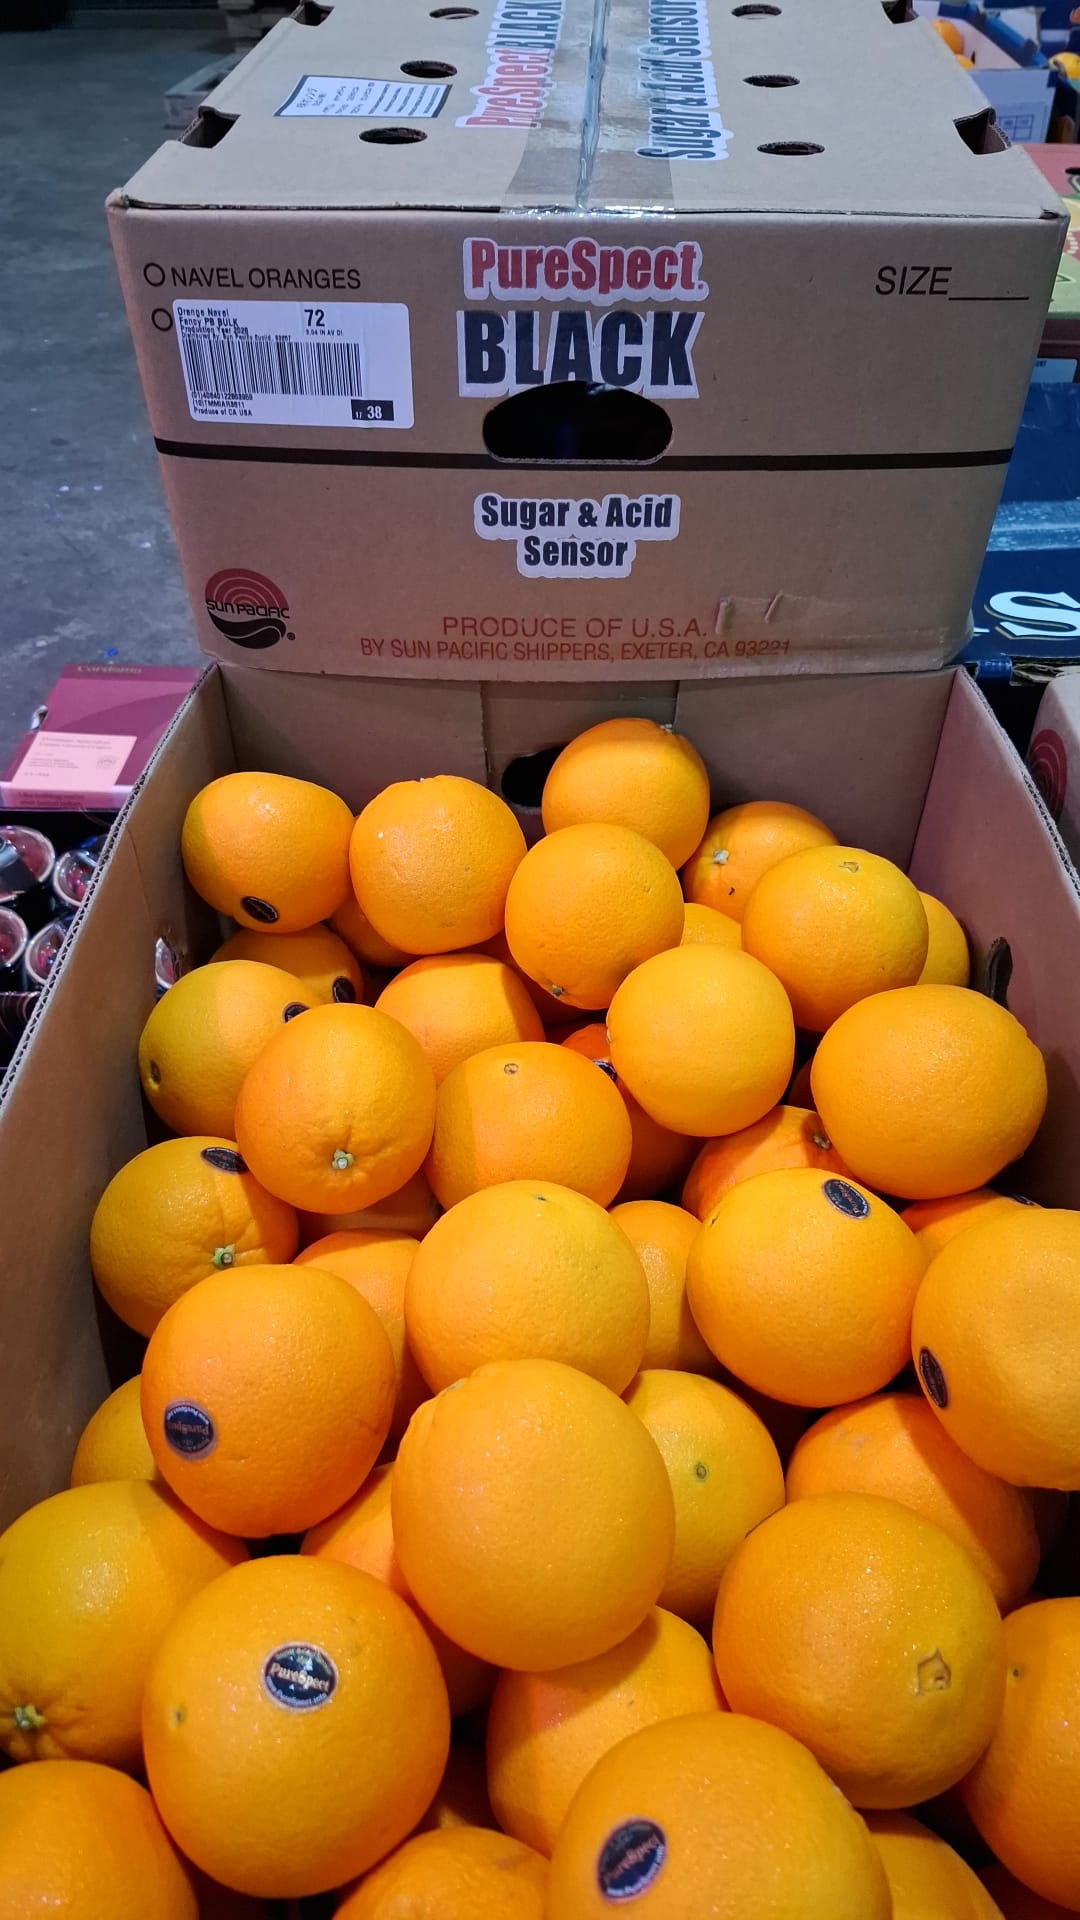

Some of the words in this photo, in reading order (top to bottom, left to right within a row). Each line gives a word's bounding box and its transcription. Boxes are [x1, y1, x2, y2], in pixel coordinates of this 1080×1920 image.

[493, 0, 562, 49] BLACK
[466, 48, 553, 129] PureSpect
[639, 58, 706, 94] Acid
[637, 107, 722, 159] Sugar
[171, 266, 244, 288] NAVEL
[248, 267, 362, 290] ORANGES
[177, 306, 205, 318] Orange
[207, 307, 229, 317] Navel
[217, 317, 239, 328] BULK
[303, 308, 325, 327] 72
[464, 309, 700, 387] BLACK
[366, 405, 383, 420] 38
[481, 495, 570, 531] Sugar
[577, 498, 599, 527] &
[604, 496, 672, 528] Acid
[523, 536, 628, 568] Sensor
[442, 615, 577, 639] PRODUCE
[584, 616, 622, 639] OF
[631, 617, 708, 639] U.S.A.
[360, 637, 385, 658] BY
[390, 639, 431, 660] SUN
[437, 640, 509, 661] PACIFIC
[512, 641, 616, 663] SHIPPERS,
[620, 640, 698, 662] EXETER,
[703, 640, 730, 660] CA
[734, 639, 791, 659] 93221
